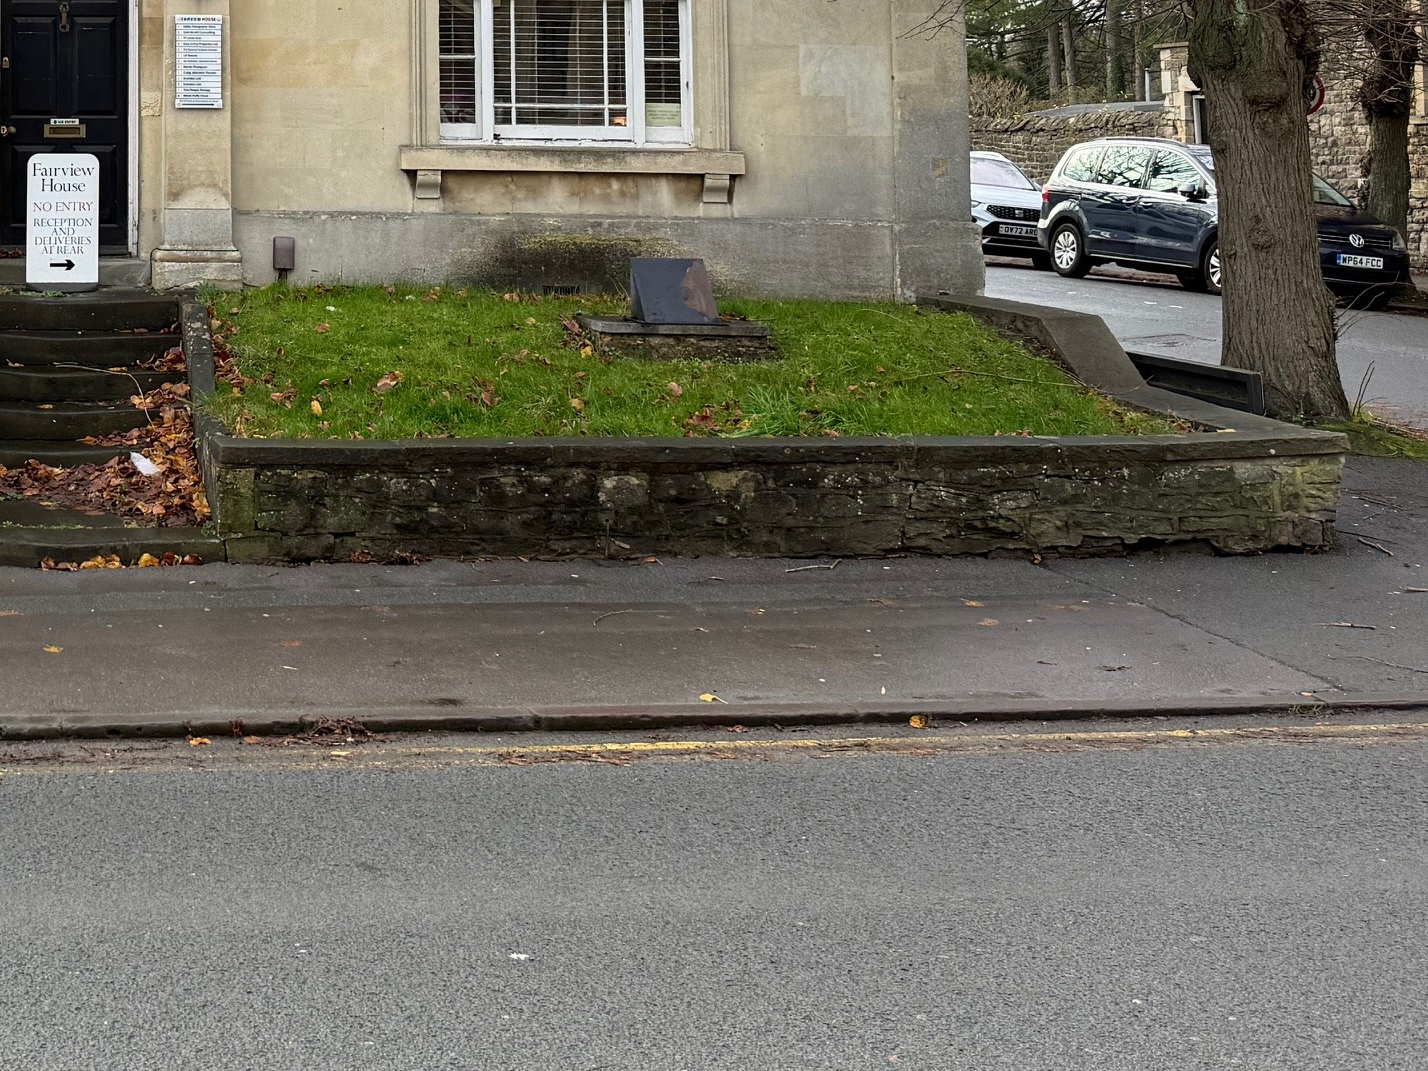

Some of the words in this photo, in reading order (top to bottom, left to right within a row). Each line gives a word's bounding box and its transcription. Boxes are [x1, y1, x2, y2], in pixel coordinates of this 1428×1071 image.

[32, 162, 95, 177] Fairview
[41, 178, 86, 192] House
[33, 201, 52, 212] NO
[55, 201, 93, 212] ENTRY
[33, 218, 93, 227] RECEPTION
[51, 227, 75, 236] AND
[34, 236, 91, 245] DELIVERIES
[41, 246, 57, 255] AT
[57, 246, 84, 255] REAR
[1342, 255, 1363, 266] WP64
[1365, 258, 1382, 268] FCC
